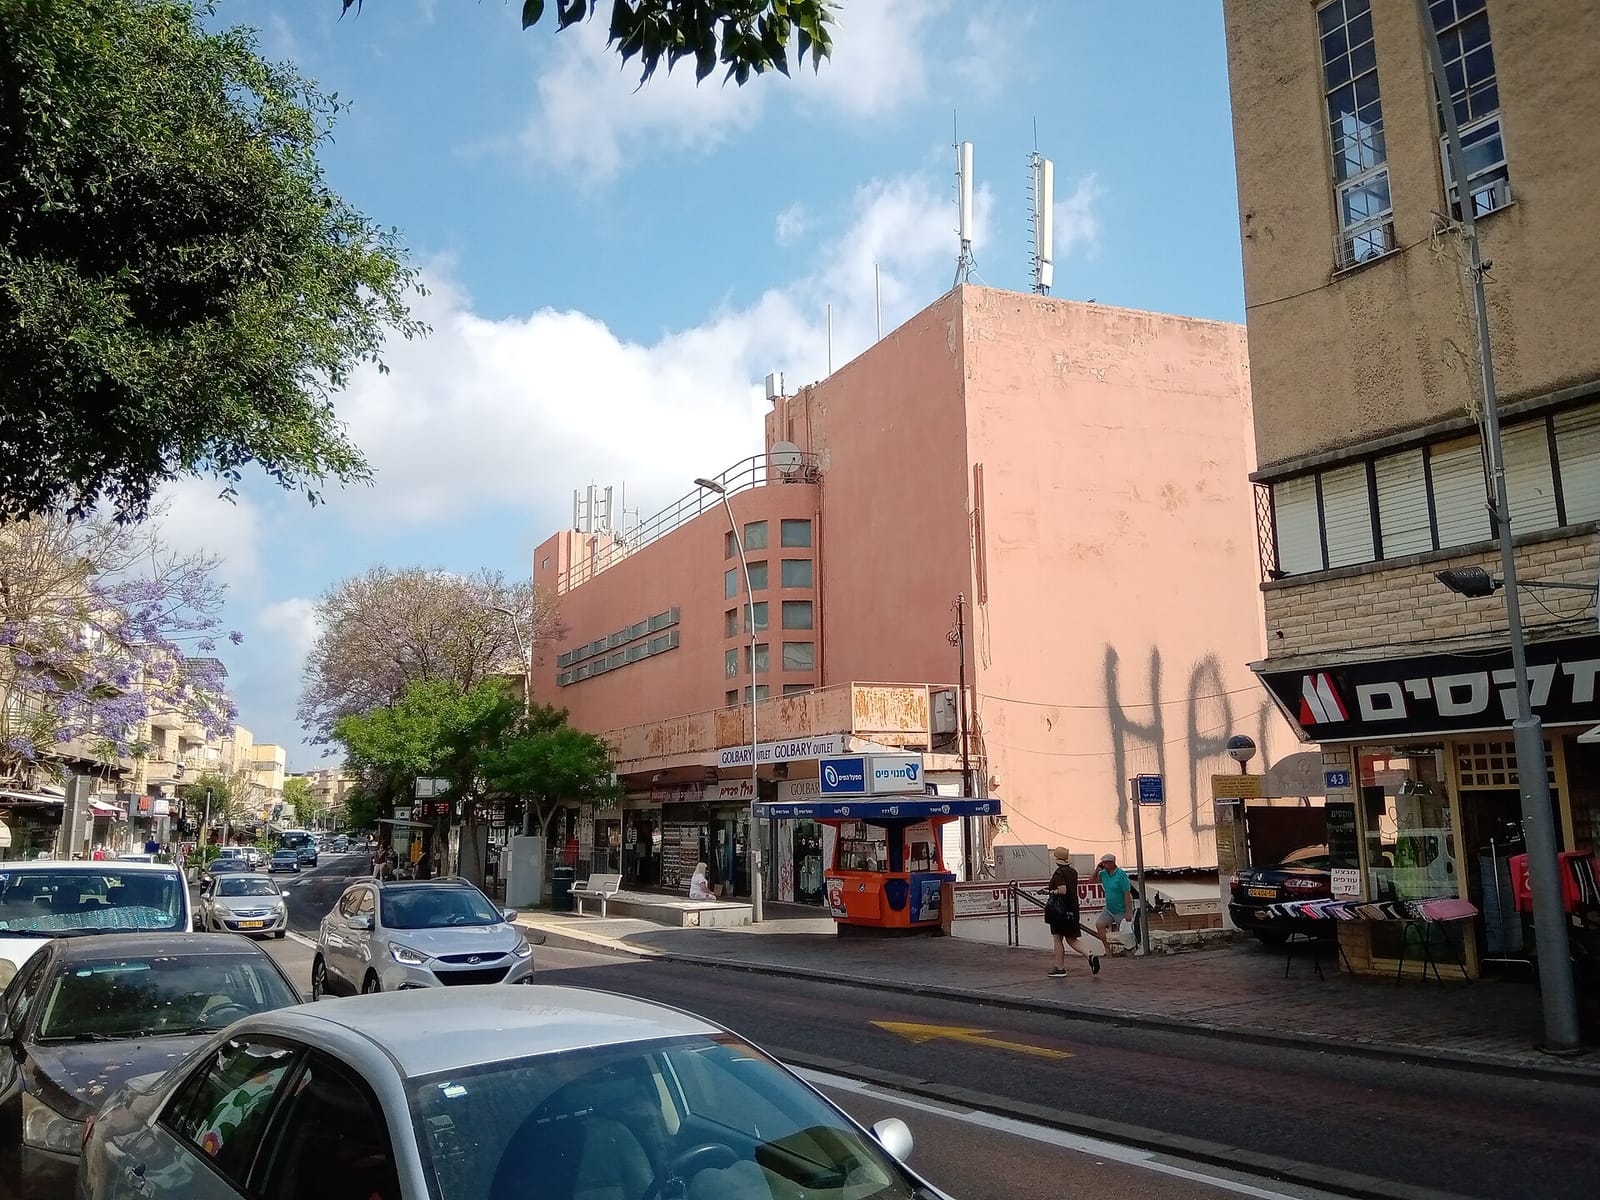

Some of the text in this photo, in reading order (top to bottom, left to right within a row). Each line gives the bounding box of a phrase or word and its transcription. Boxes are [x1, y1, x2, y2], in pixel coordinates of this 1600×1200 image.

[722, 742, 834, 764] GOLBARY UTLET GOLBARY OUTLET
[875, 768, 905, 778] מנוי פיס
[1330, 773, 1344, 785] 43
